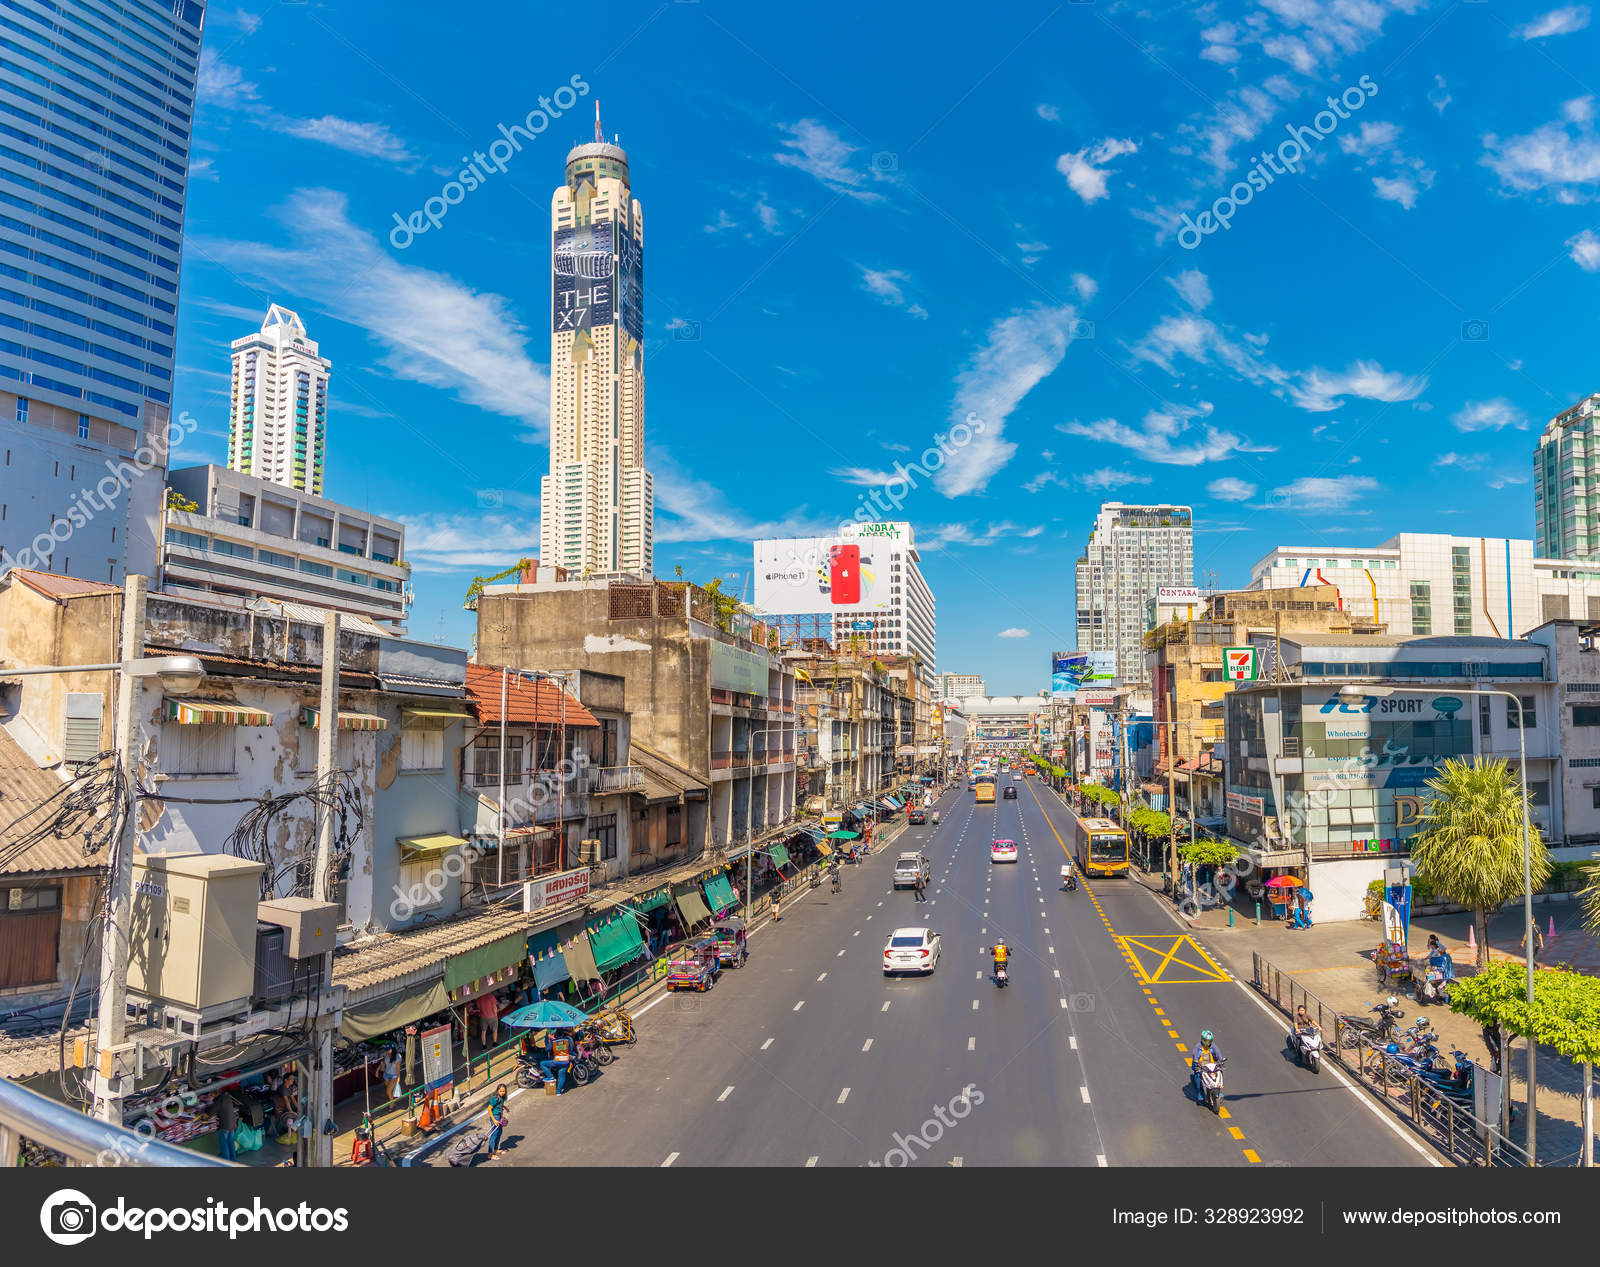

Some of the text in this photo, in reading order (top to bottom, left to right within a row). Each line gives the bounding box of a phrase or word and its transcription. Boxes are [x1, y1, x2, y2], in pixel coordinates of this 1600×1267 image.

[559, 285, 609, 308] THE
[558, 308, 588, 329] X7
[863, 524, 896, 533] INDRA
[771, 572, 805, 581] iPhone 11
[1160, 587, 1197, 597] CENTARA
[1381, 699, 1423, 713] SPORT
[1353, 838, 1401, 852] NIGHT
[135, 881, 162, 895] PYT109
[545, 871, 589, 894] แสงเจริญ
